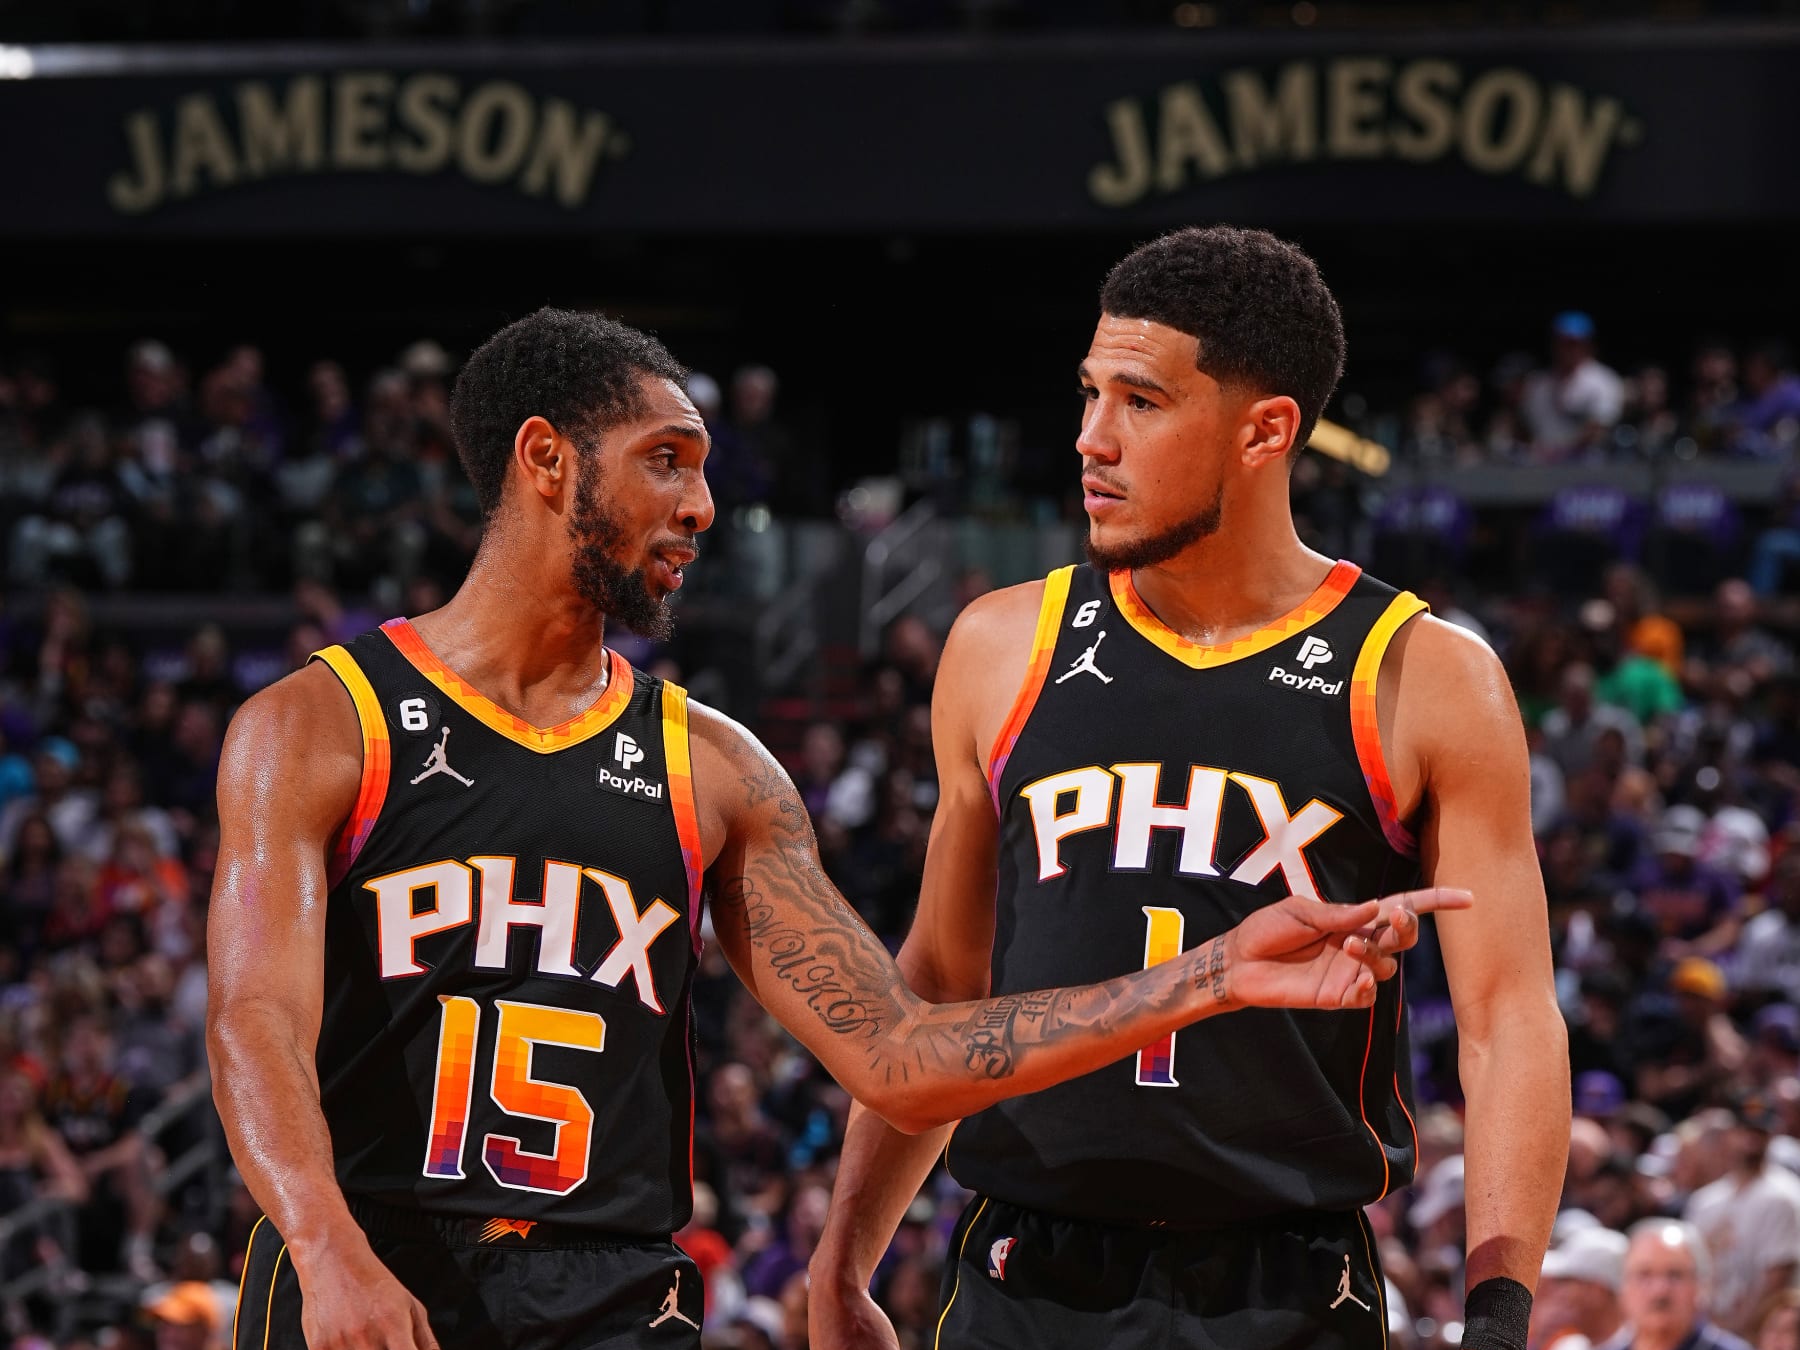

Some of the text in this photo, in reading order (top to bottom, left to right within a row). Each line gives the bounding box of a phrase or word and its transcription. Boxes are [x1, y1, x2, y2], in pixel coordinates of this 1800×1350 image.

[110, 73, 608, 211] JAMESON
[1090, 59, 1618, 205] JAMESON
[1072, 600, 1101, 628] 6
[1268, 666, 1343, 696] PayPal
[399, 697, 429, 731] 6
[598, 768, 663, 799] PayPal
[1018, 763, 1345, 904] PHX
[362, 855, 681, 1015] PHX
[1135, 905, 1185, 1087] 1
[422, 994, 607, 1196] 15
